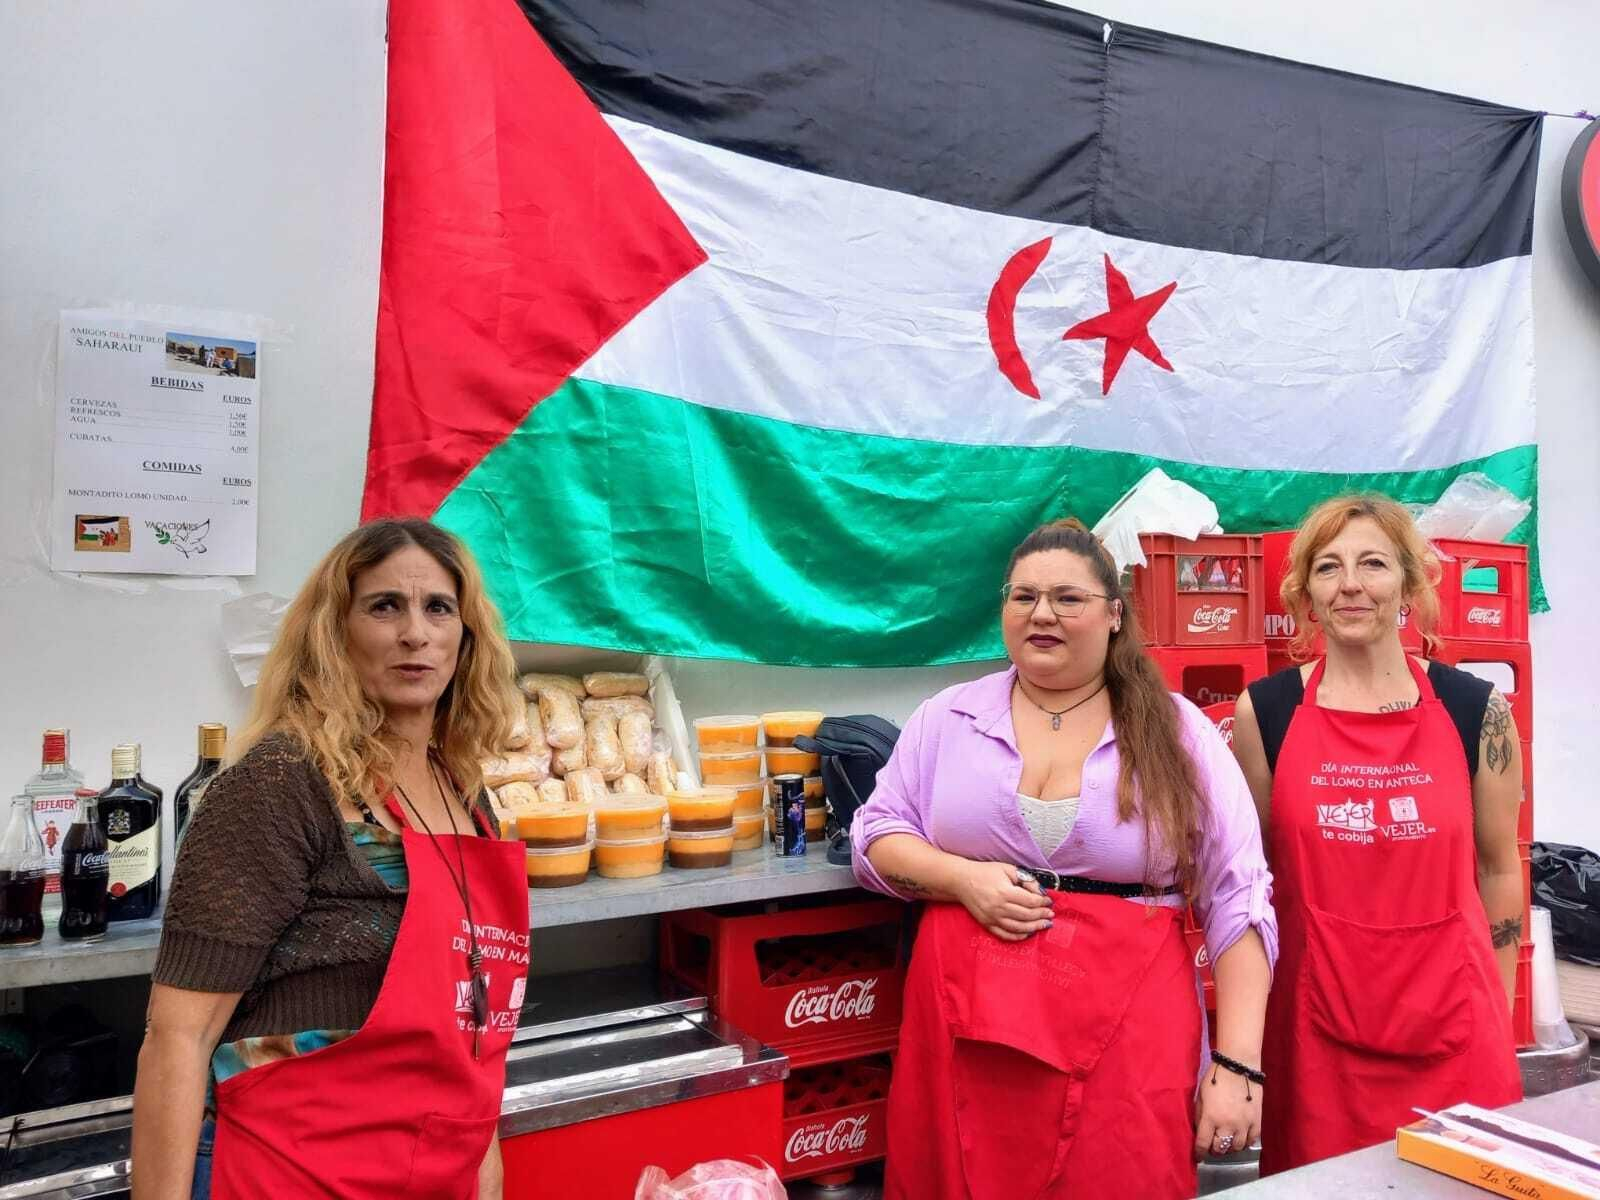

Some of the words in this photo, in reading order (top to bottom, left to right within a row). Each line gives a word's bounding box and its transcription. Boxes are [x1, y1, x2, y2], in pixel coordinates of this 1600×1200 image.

[70, 327, 107, 337] AMIGOS
[129, 334, 164, 343] PUEBLO
[151, 376, 204, 390] BEBIDAS
[70, 398, 117, 408] CERVEZAS
[223, 394, 252, 404] EUROS
[70, 407, 121, 417] REFRESCOS
[70, 416, 96, 424] AGUA
[70, 433, 112, 441] CUBATAS
[143, 460, 202, 473] COMIDAS
[223, 477, 251, 486] EUROS
[68, 488, 123, 498] MONTADITO
[124, 491, 151, 500] LOMO
[144, 520, 198, 532] VACACIONES
[1321, 762, 1337, 773] DÍA
[1311, 775, 1329, 786] DEL
[1332, 776, 1365, 788] LOMO
[1368, 779, 1384, 789] EN
[1322, 829, 1335, 840] te
[1337, 831, 1375, 845] cobija
[785, 977, 878, 1028] Coca-Cola
[784, 1113, 870, 1162] Coca-Cola
